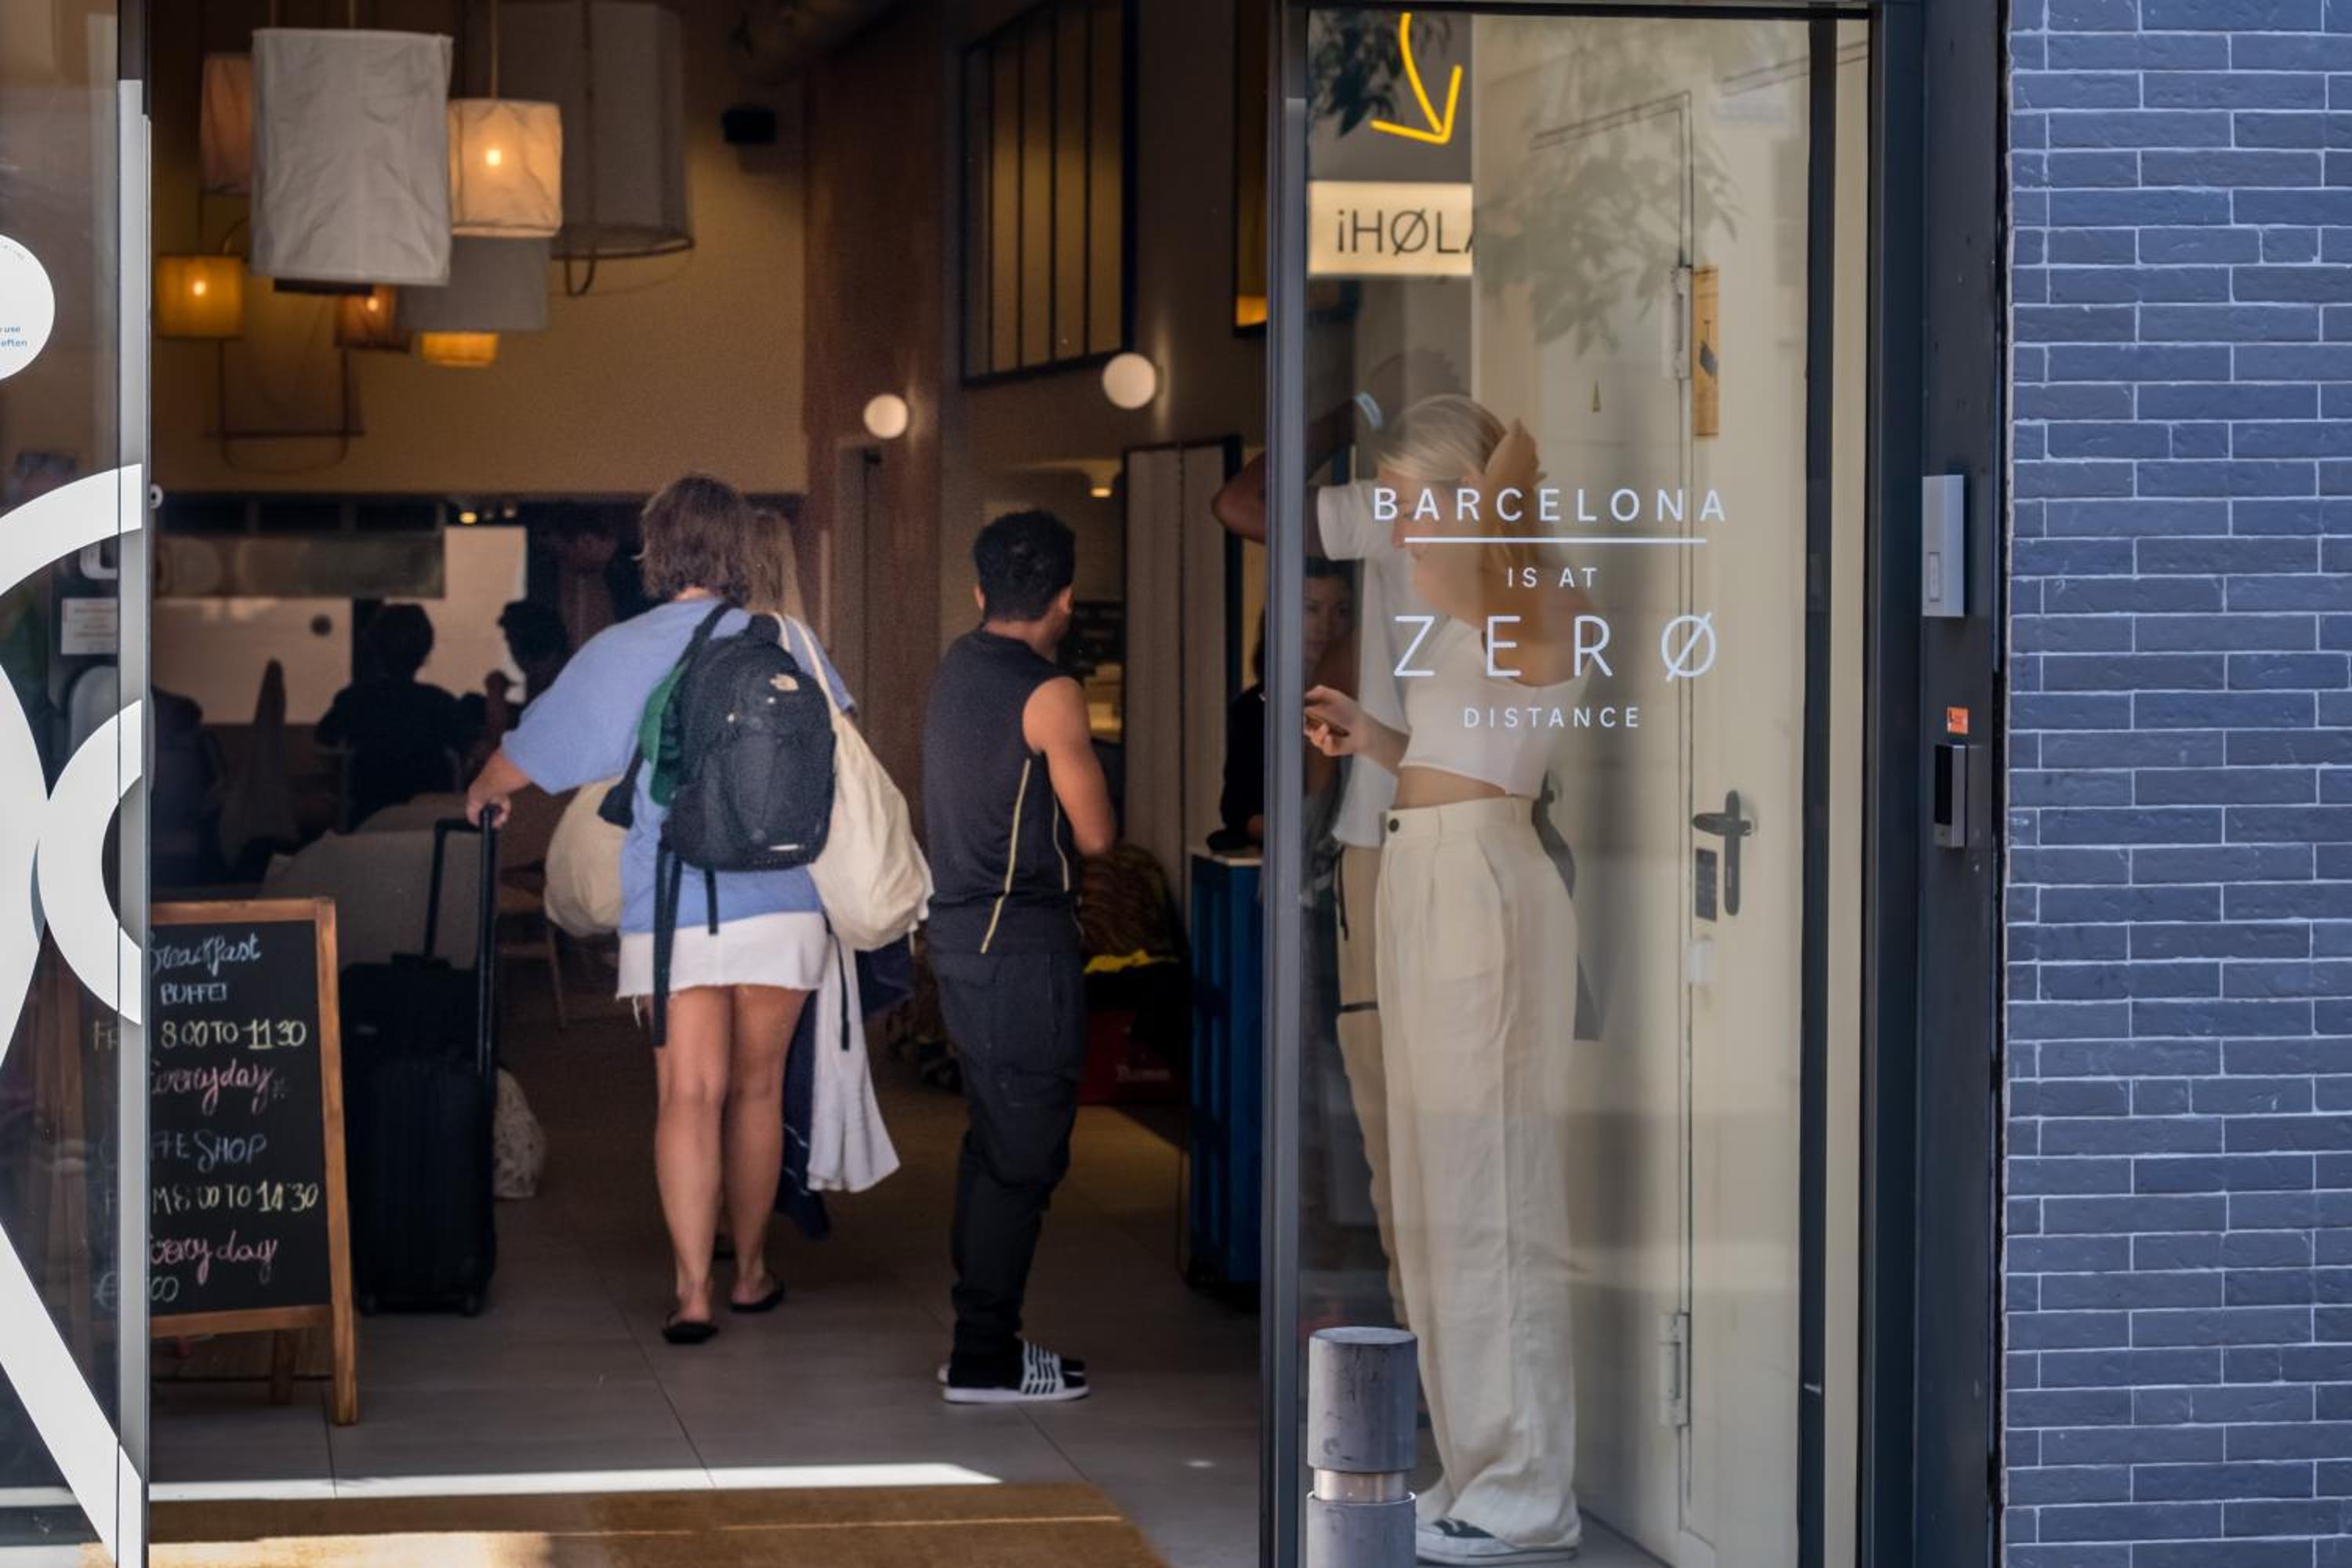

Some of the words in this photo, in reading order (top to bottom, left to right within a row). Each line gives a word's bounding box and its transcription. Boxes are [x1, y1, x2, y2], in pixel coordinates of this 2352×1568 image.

[1338, 209, 1473, 256] ¡HØL
[1374, 488, 1725, 521] BARCELONA
[1508, 568, 1537, 588] IS
[1559, 568, 1597, 588] AT
[1393, 612, 1717, 682] ZERØ
[1464, 707, 1639, 728] DISTANCE
[194, 1129, 267, 1173] SHOP
